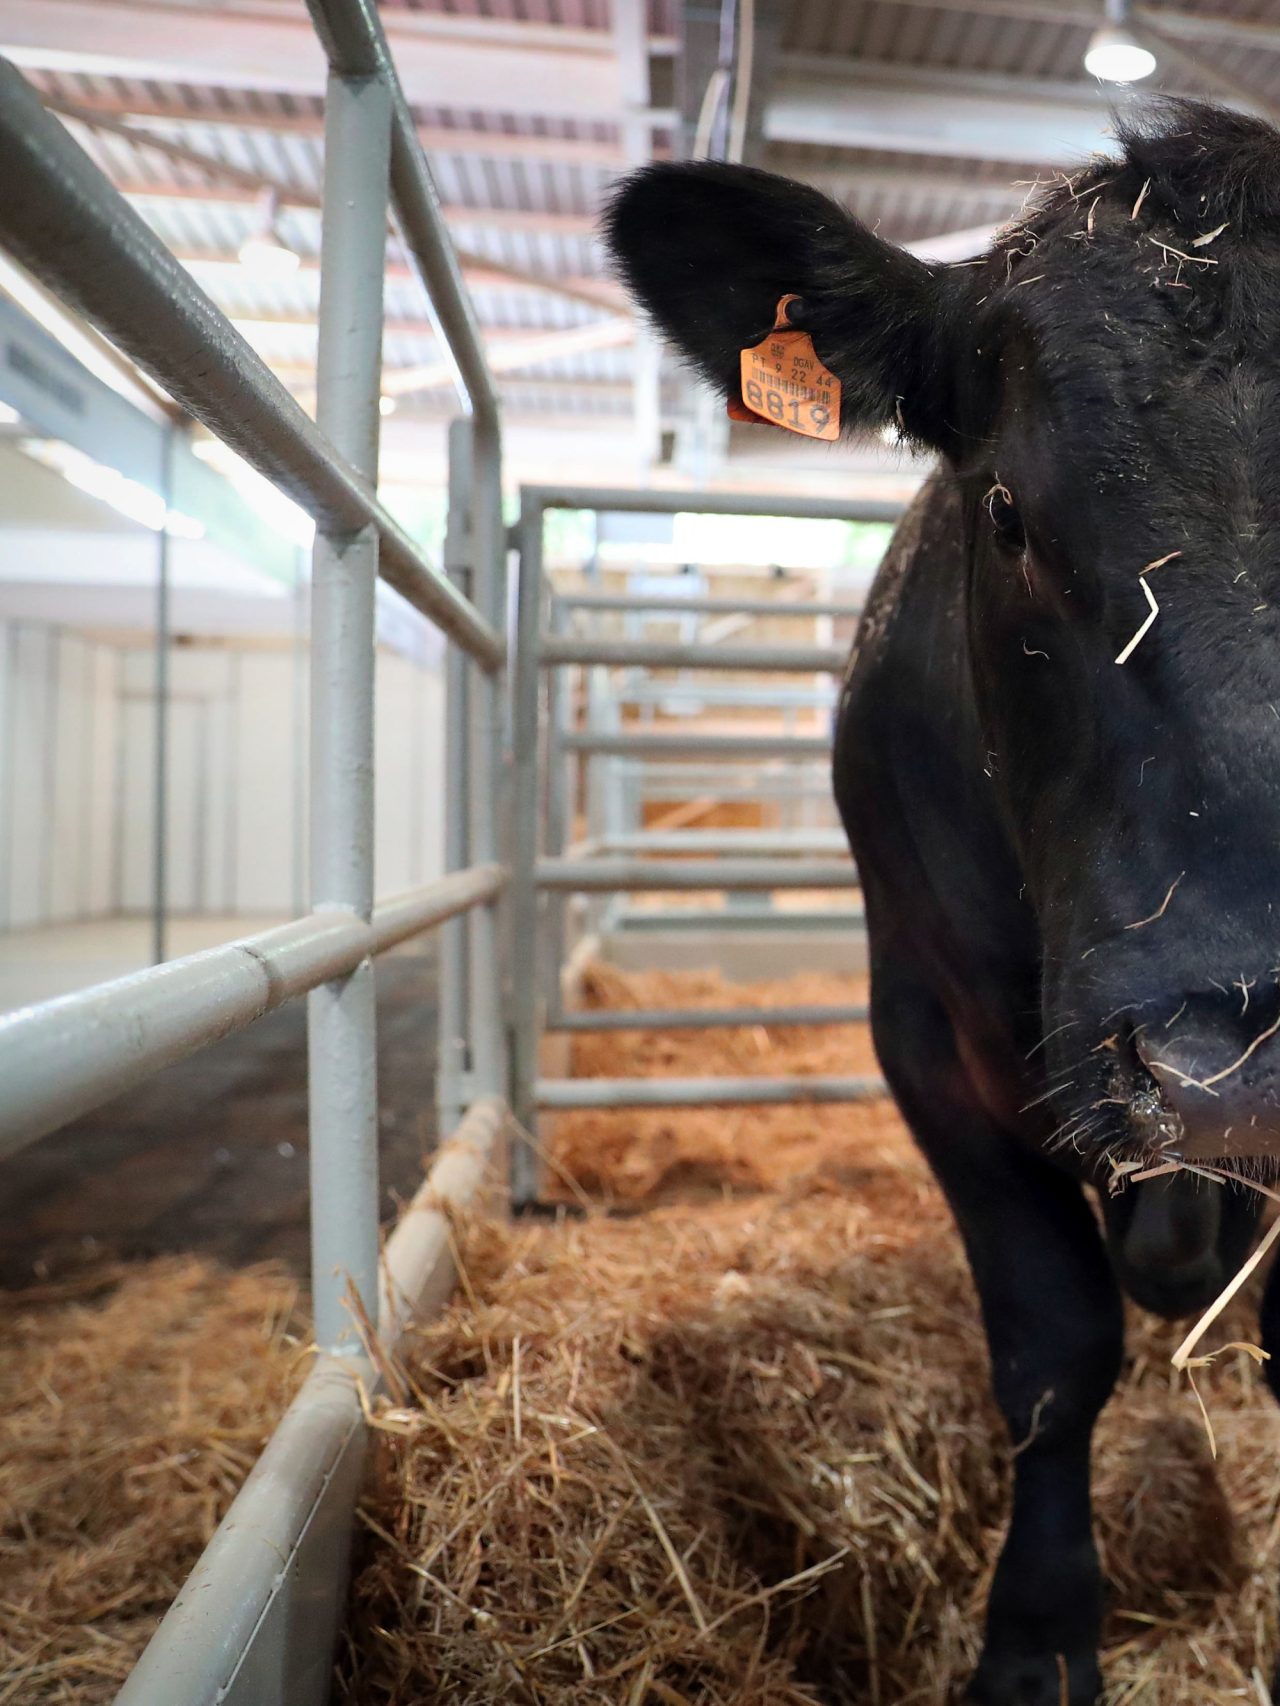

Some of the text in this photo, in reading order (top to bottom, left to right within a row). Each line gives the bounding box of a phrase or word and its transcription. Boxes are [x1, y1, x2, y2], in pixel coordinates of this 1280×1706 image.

[752, 353, 832, 388] PT 9 22 44
[793, 357, 814, 370] DGAV
[746, 379, 830, 435] 8819
